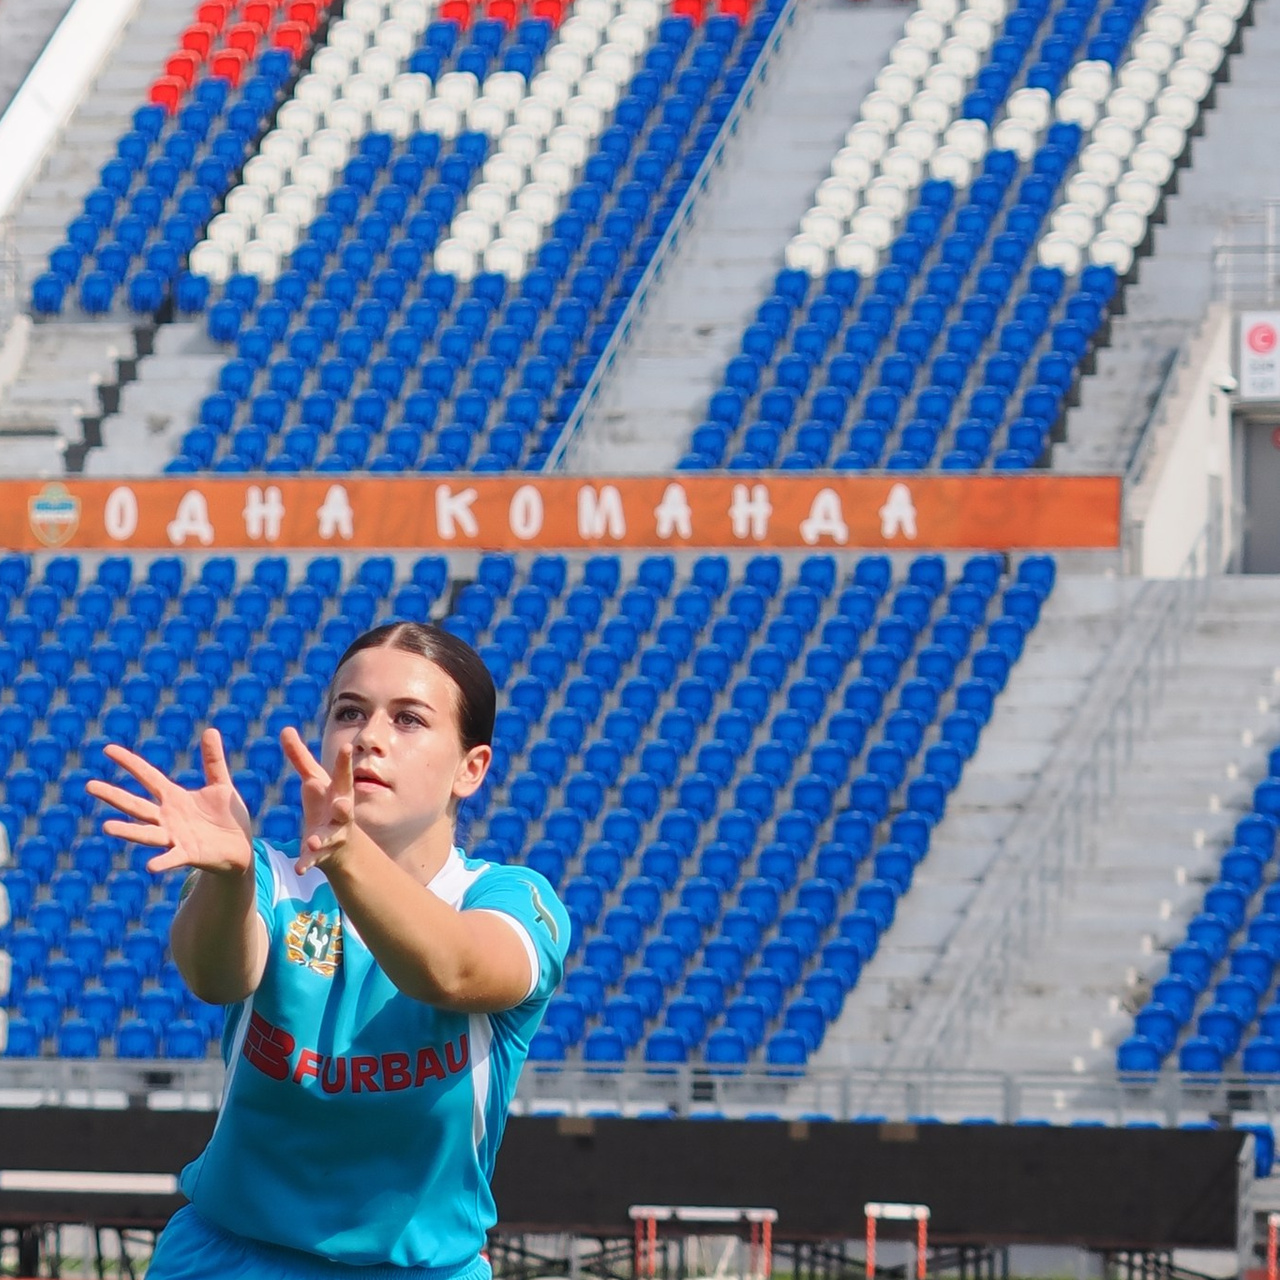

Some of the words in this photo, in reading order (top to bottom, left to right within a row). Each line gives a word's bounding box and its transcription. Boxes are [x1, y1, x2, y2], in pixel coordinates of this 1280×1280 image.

[104, 485, 355, 546] ОДНА
[433, 482, 918, 545] КОМАНДА
[293, 1034, 469, 1093] FURBAU
